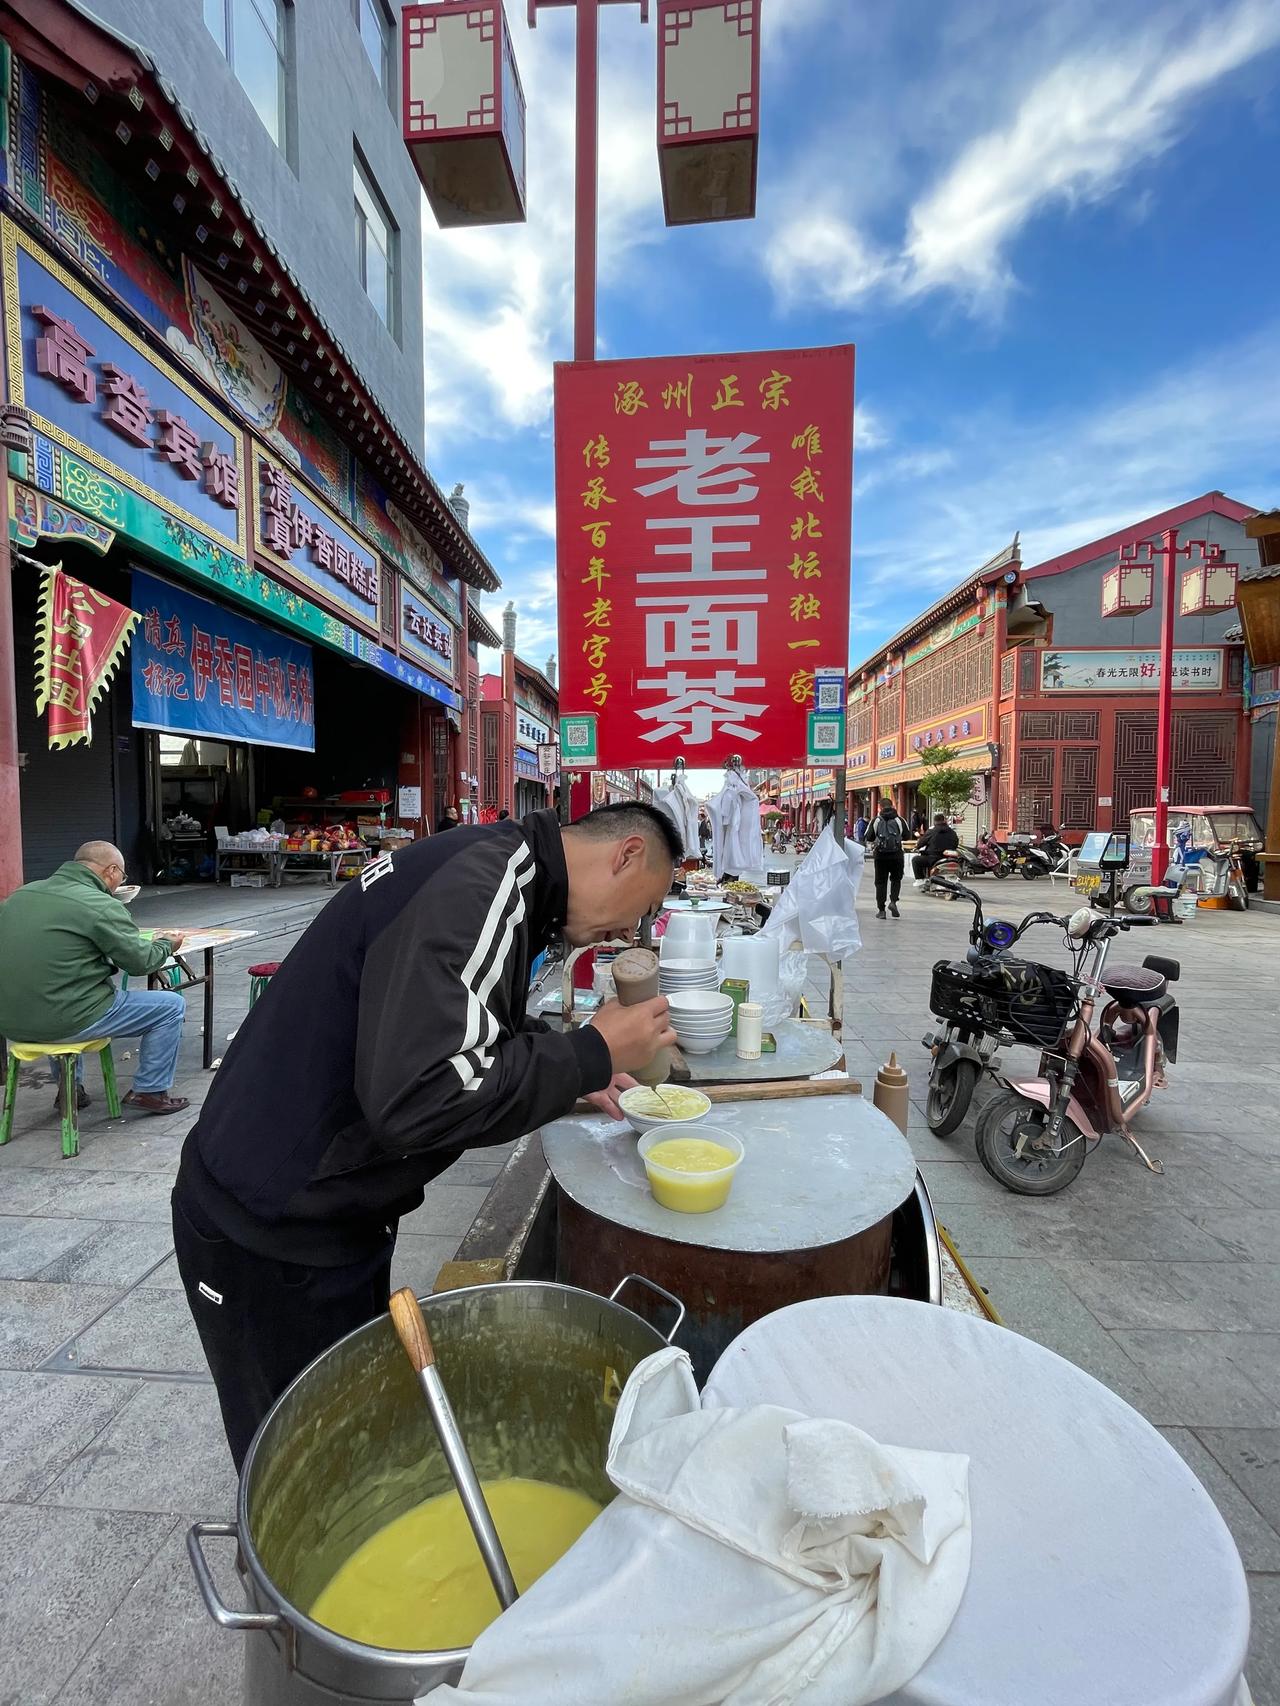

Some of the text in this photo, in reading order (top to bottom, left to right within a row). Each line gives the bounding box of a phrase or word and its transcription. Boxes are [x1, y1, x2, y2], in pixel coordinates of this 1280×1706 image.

[31, 304, 239, 509] 高登宾馆
[614, 369, 793, 417] 涿州正宗
[261, 461, 294, 560] 清真
[291, 503, 380, 605] 伊香园糕点
[580, 434, 616, 707] 传承百年老字号
[633, 428, 770, 746] 老王面茶
[144, 606, 186, 657] 清真
[1096, 662, 1212, 678] 春光无限好是读书时
